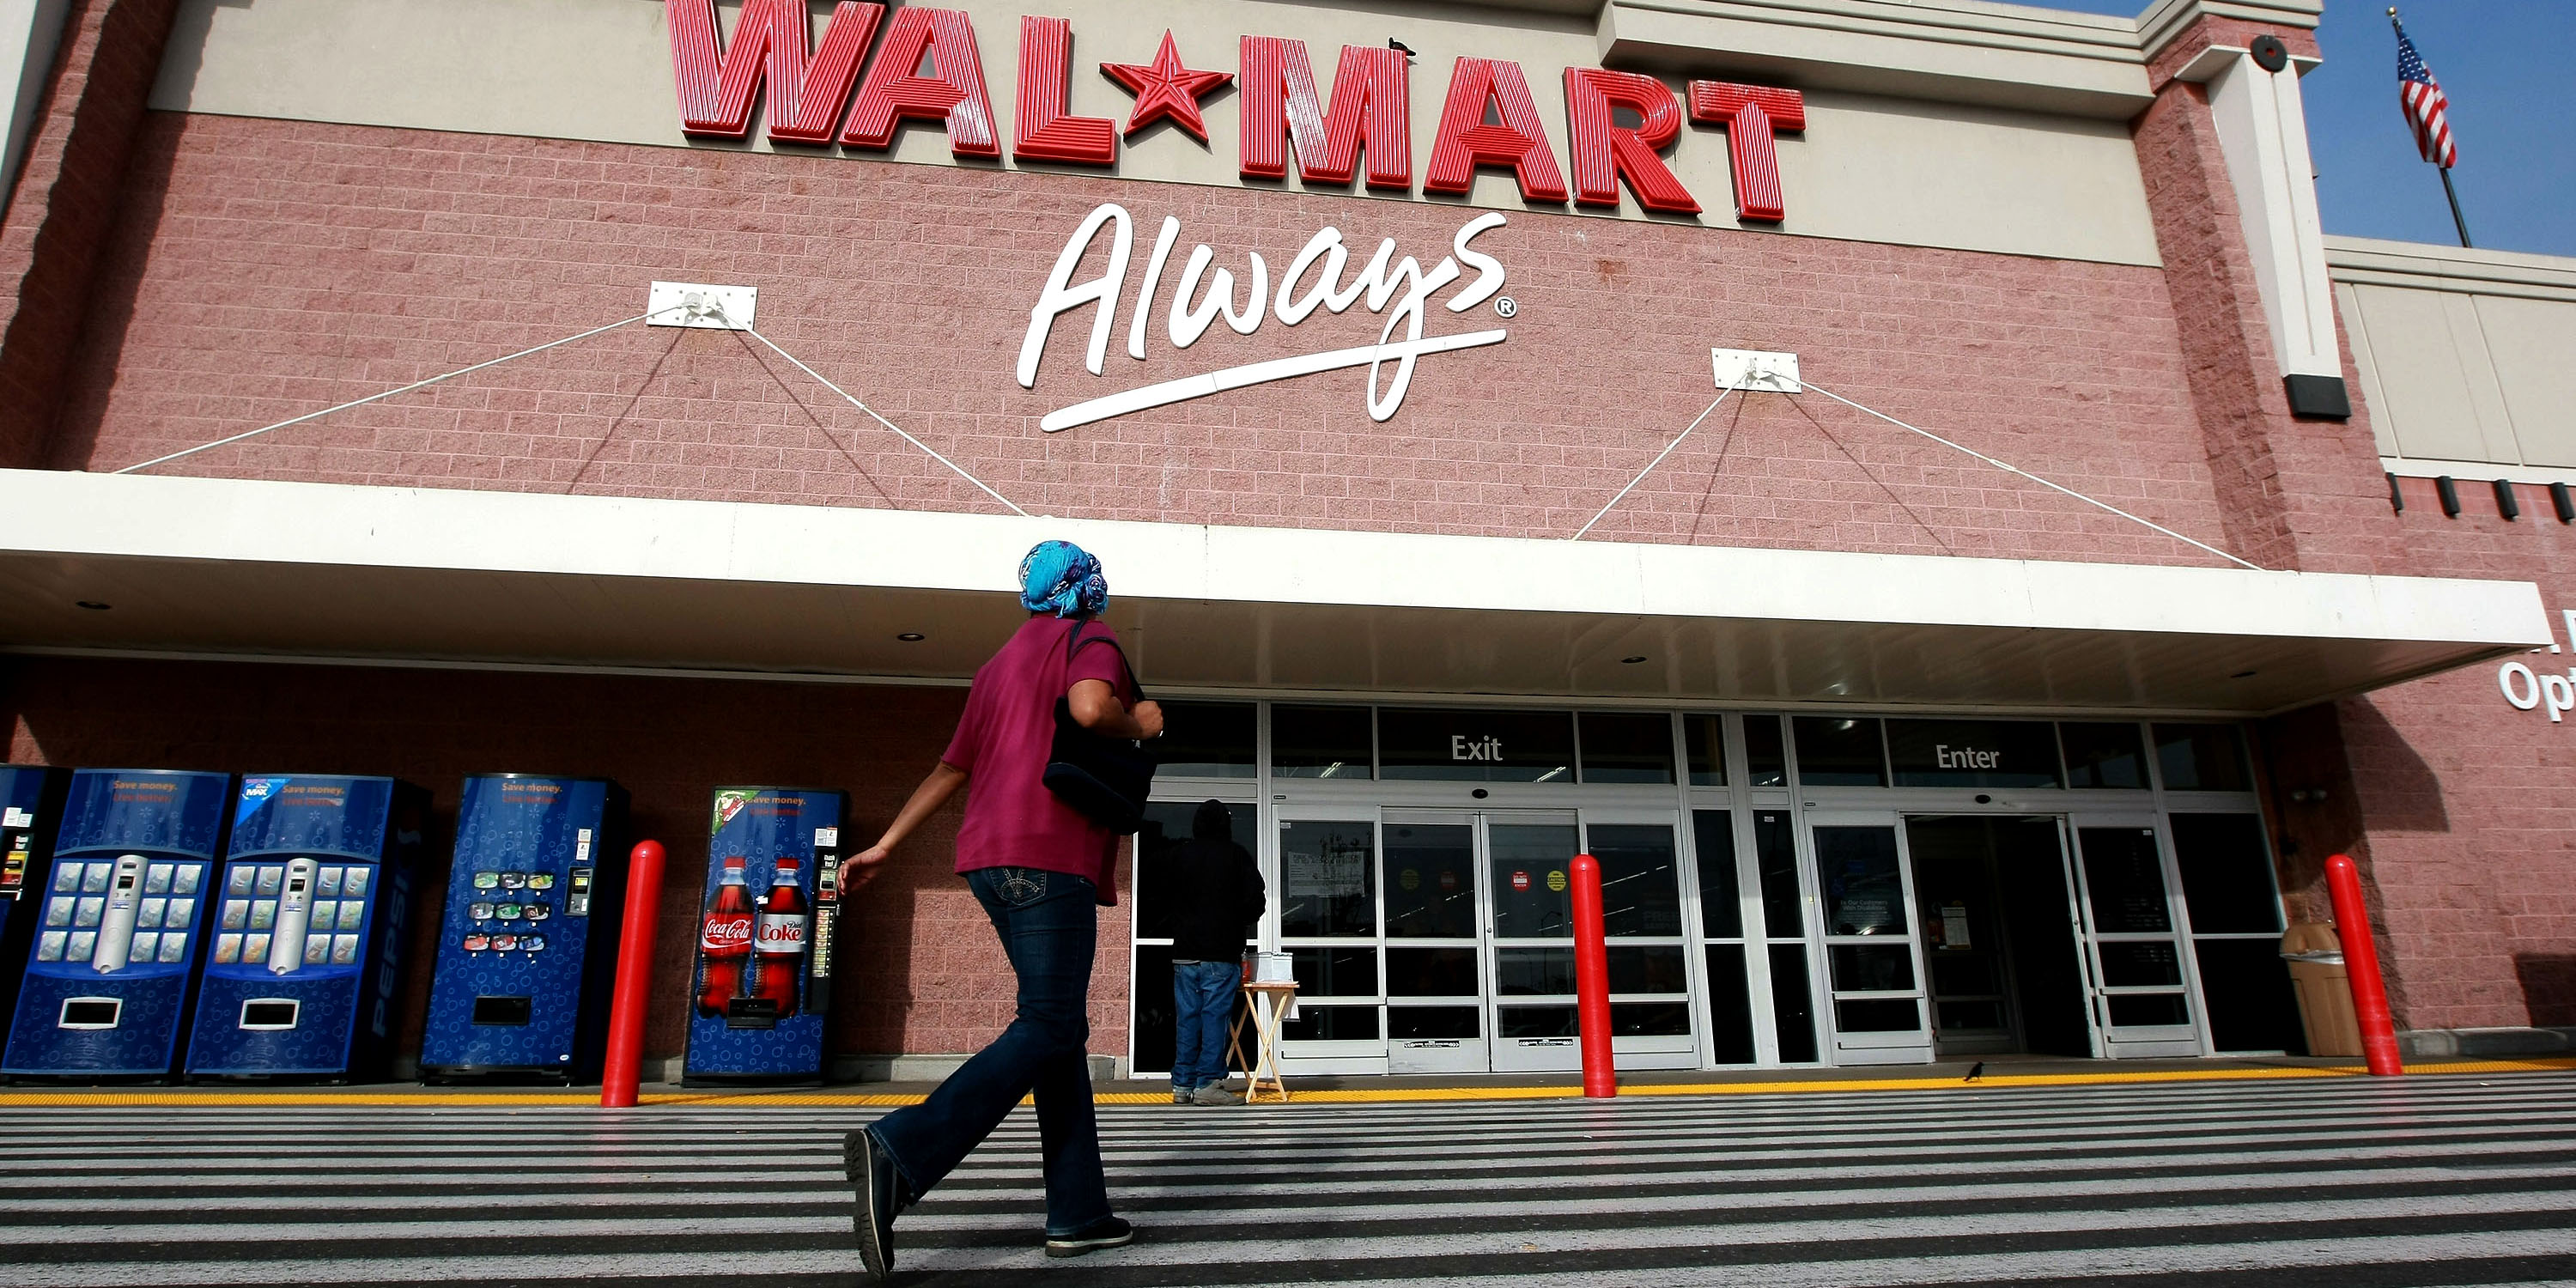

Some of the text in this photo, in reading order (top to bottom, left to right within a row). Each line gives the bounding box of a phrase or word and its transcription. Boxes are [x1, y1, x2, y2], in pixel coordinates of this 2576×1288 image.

[1016, 203, 1509, 422] Always
[1451, 735, 1504, 762] Exit
[1936, 744, 2000, 769] Enter
[113, 780, 179, 793] Save money.
[283, 785, 345, 796] Save money.
[501, 782, 562, 793] Save money.
[772, 797, 806, 806] money.
[759, 923, 801, 941] Coke
[373, 874, 408, 1038] PEPSI
